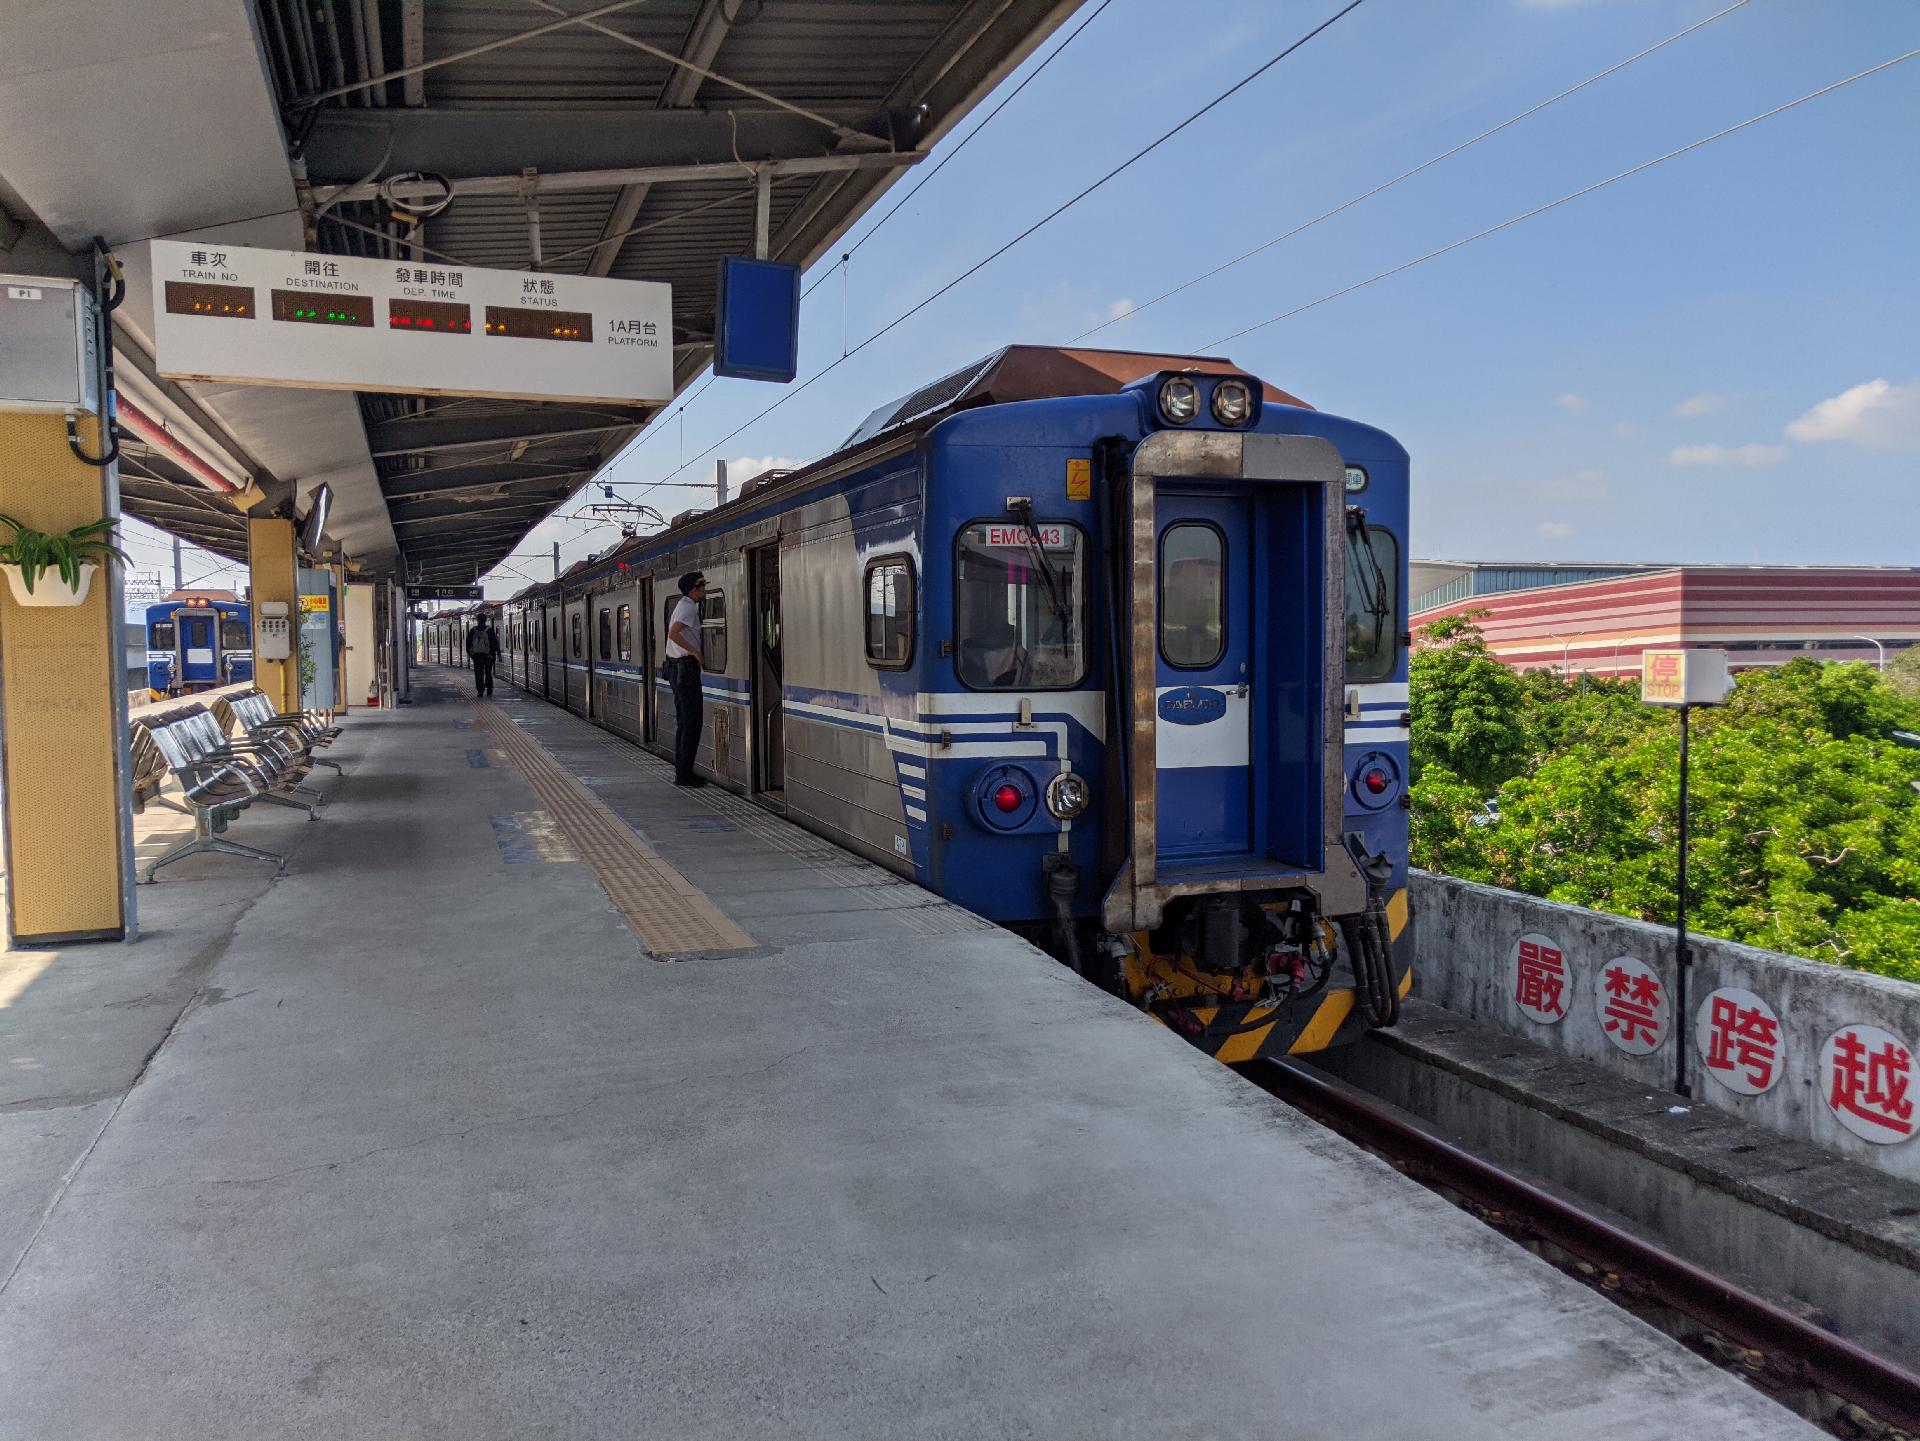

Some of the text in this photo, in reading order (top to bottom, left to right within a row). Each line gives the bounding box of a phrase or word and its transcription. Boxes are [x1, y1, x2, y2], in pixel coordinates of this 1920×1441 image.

[190, 251, 228, 268] 車次
[182, 269, 238, 282] TRAIN NO
[305, 260, 340, 277] 開往
[286, 278, 359, 291] DESTINATION
[395, 267, 463, 288] 發車時間
[403, 287, 456, 299] DEP. TIME
[523, 278, 555, 295] 狀態
[520, 296, 558, 307] STATUS
[608, 336, 658, 348] PLATFORM
[1650, 655, 1680, 683] 停
[1647, 684, 1680, 698] STOP
